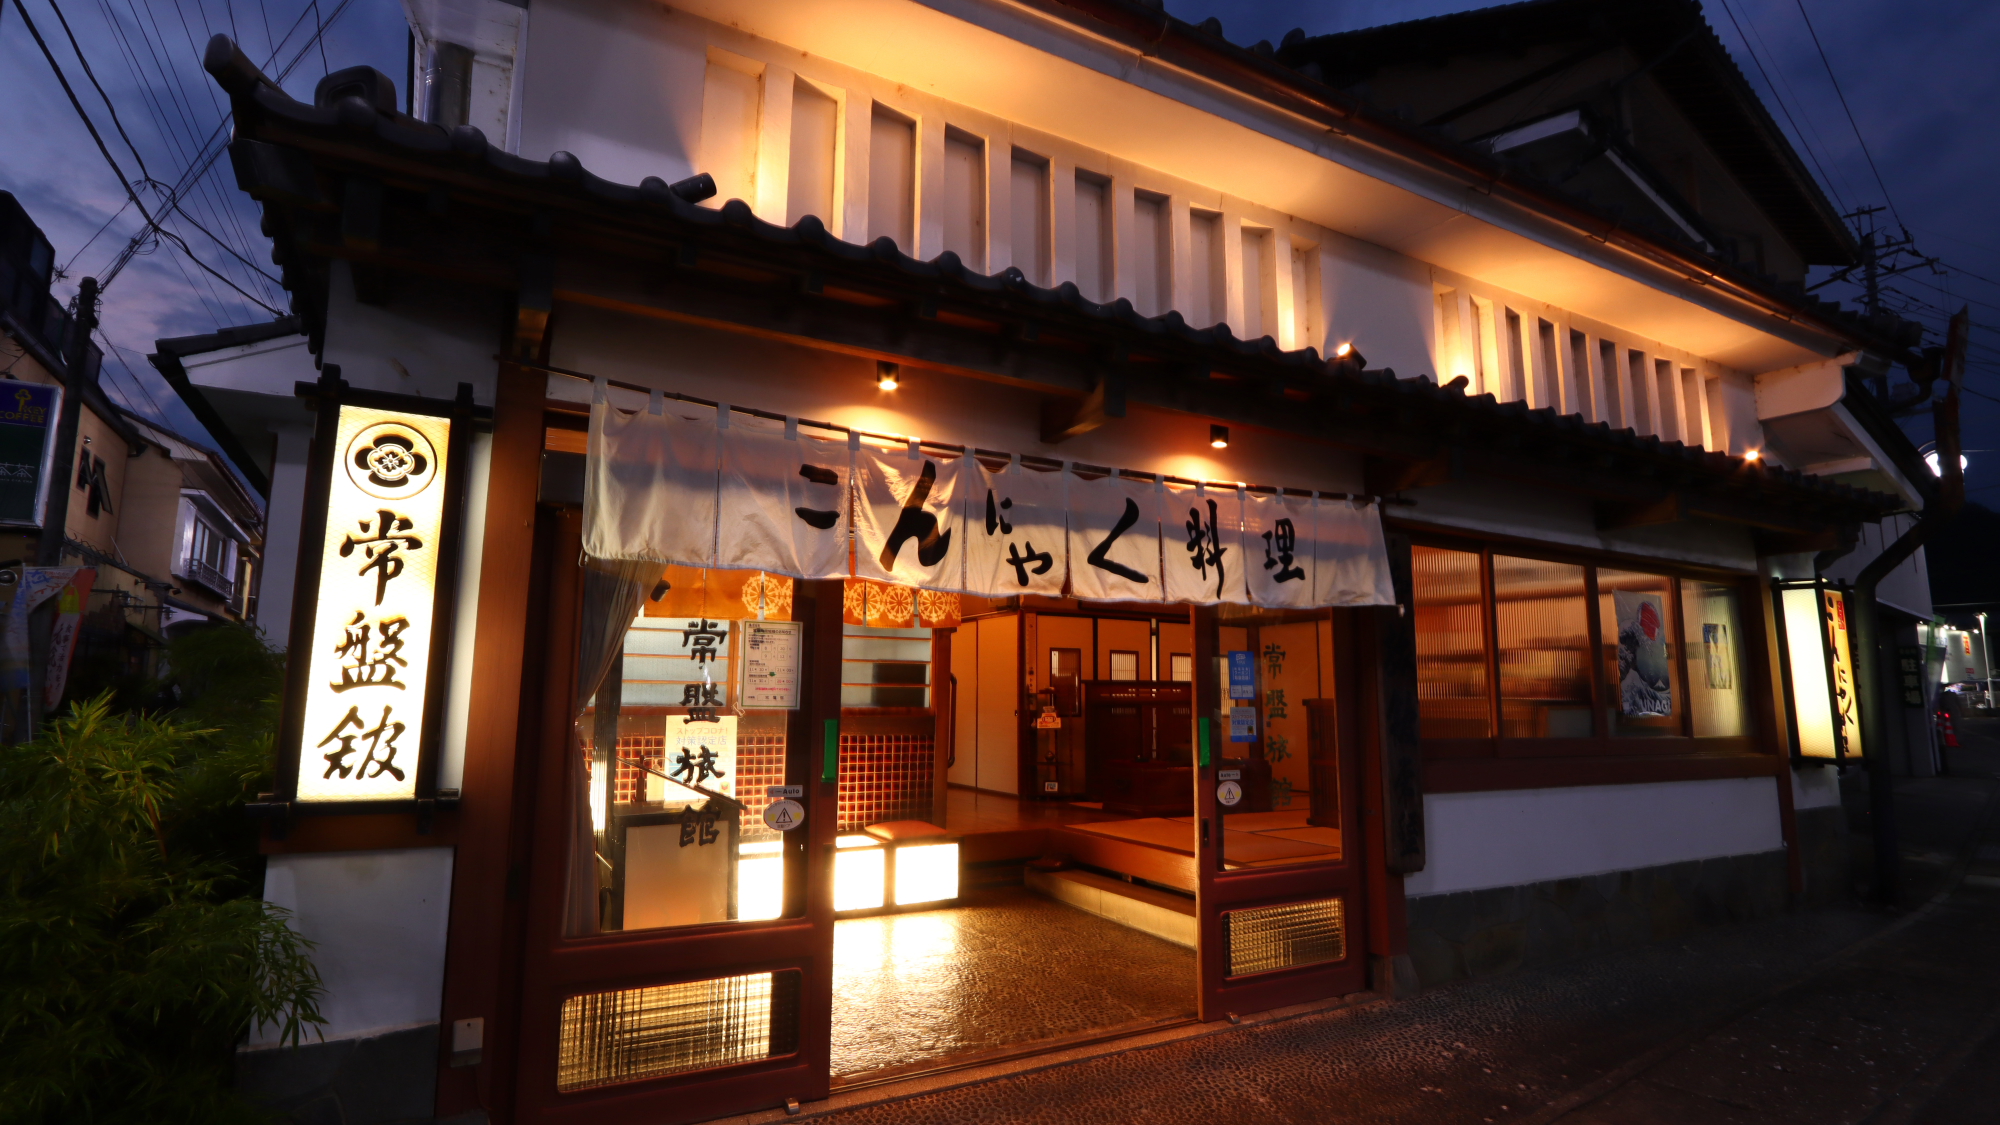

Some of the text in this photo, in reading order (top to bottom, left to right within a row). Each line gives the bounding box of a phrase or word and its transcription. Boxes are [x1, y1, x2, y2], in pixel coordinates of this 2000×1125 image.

[795, 459, 1306, 600] こんにゃく料理
[672, 617, 728, 849] 常盤旅館
[676, 727, 729, 735] ストップコロナ!
[676, 736, 728, 746] 対策認定店
